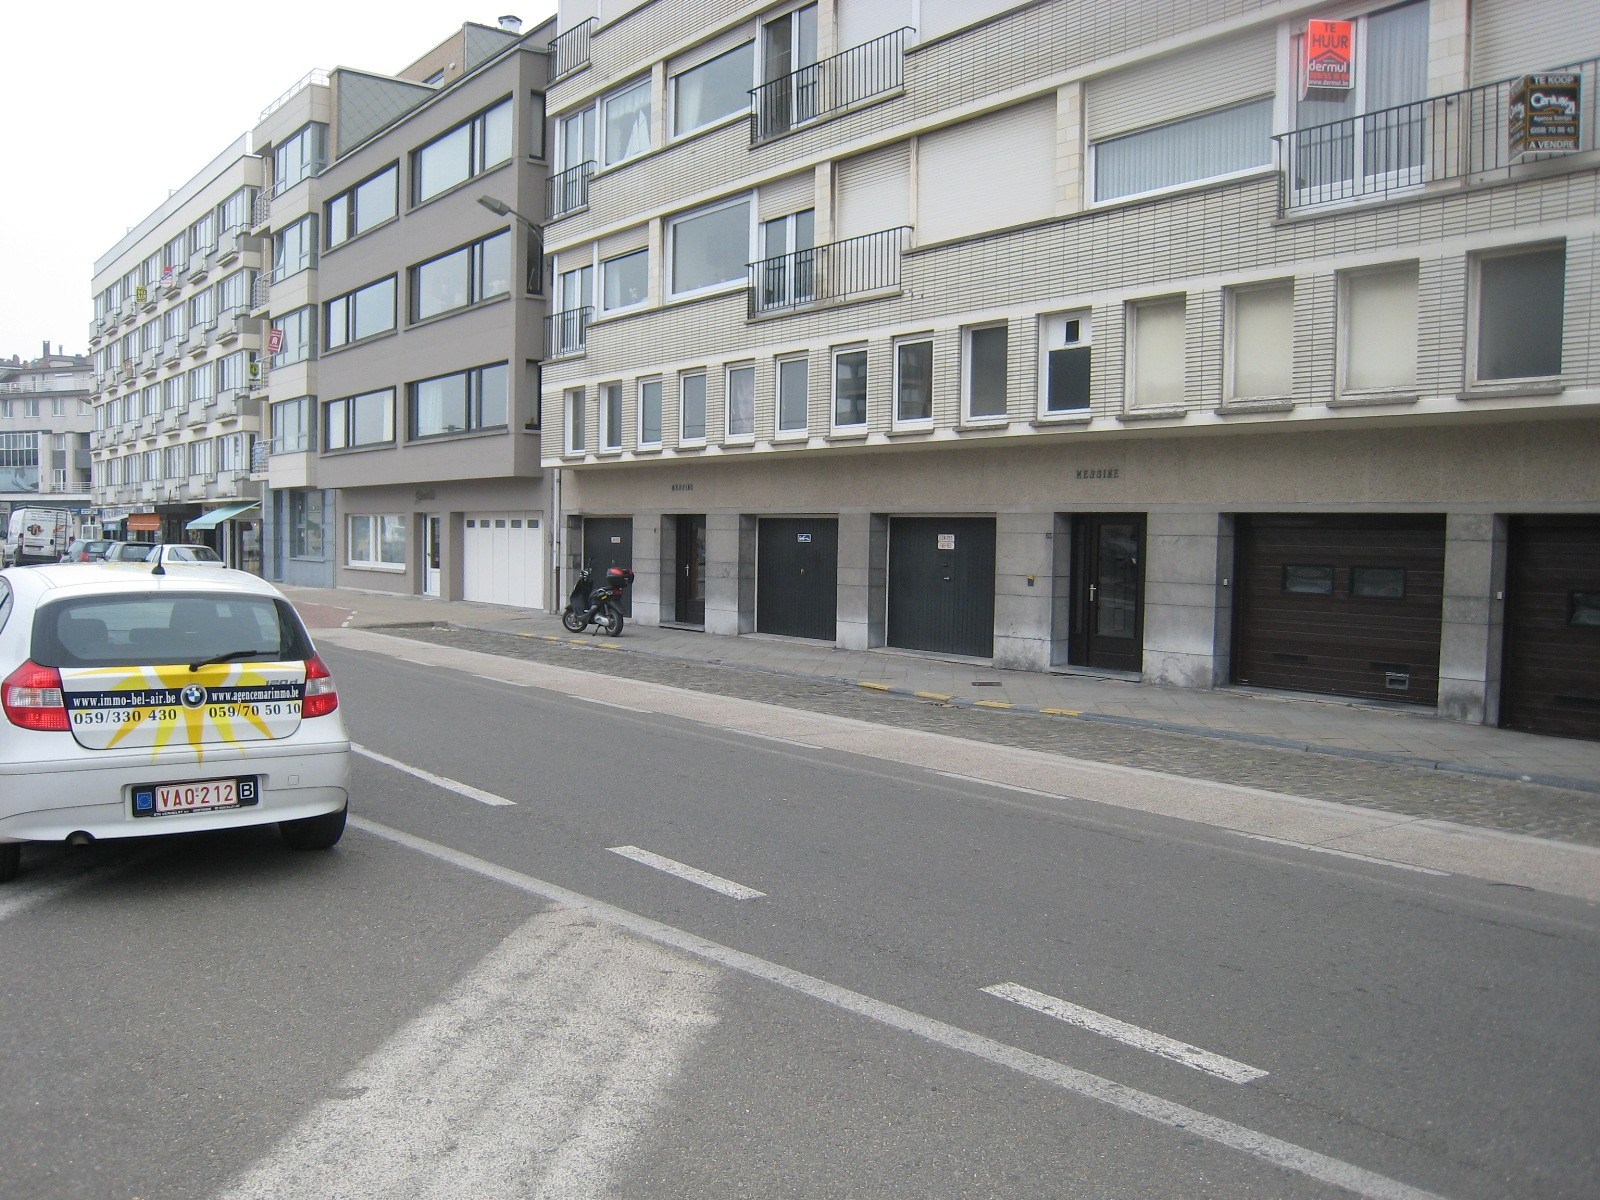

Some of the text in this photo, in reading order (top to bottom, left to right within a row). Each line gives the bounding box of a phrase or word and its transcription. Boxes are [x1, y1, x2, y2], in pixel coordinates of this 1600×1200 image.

[1324, 23, 1336, 32] TE
[1312, 34, 1349, 49] HUUR
[1309, 60, 1347, 73] dermul
[1533, 76, 1574, 84] TE KOOP
[1530, 92, 1576, 114] Century 21
[1548, 126, 1556, 134] 70
[1529, 140, 1575, 149] A VENDRE
[1076, 469, 1119, 479] MESSINE
[73, 690, 176, 707] www.immo-bel-air.be
[211, 685, 299, 703] www.agencemarimmo.be
[74, 709, 177, 725] 059/330 430
[209, 703, 301, 718] 059/70 50 10
[241, 783, 253, 797] B
